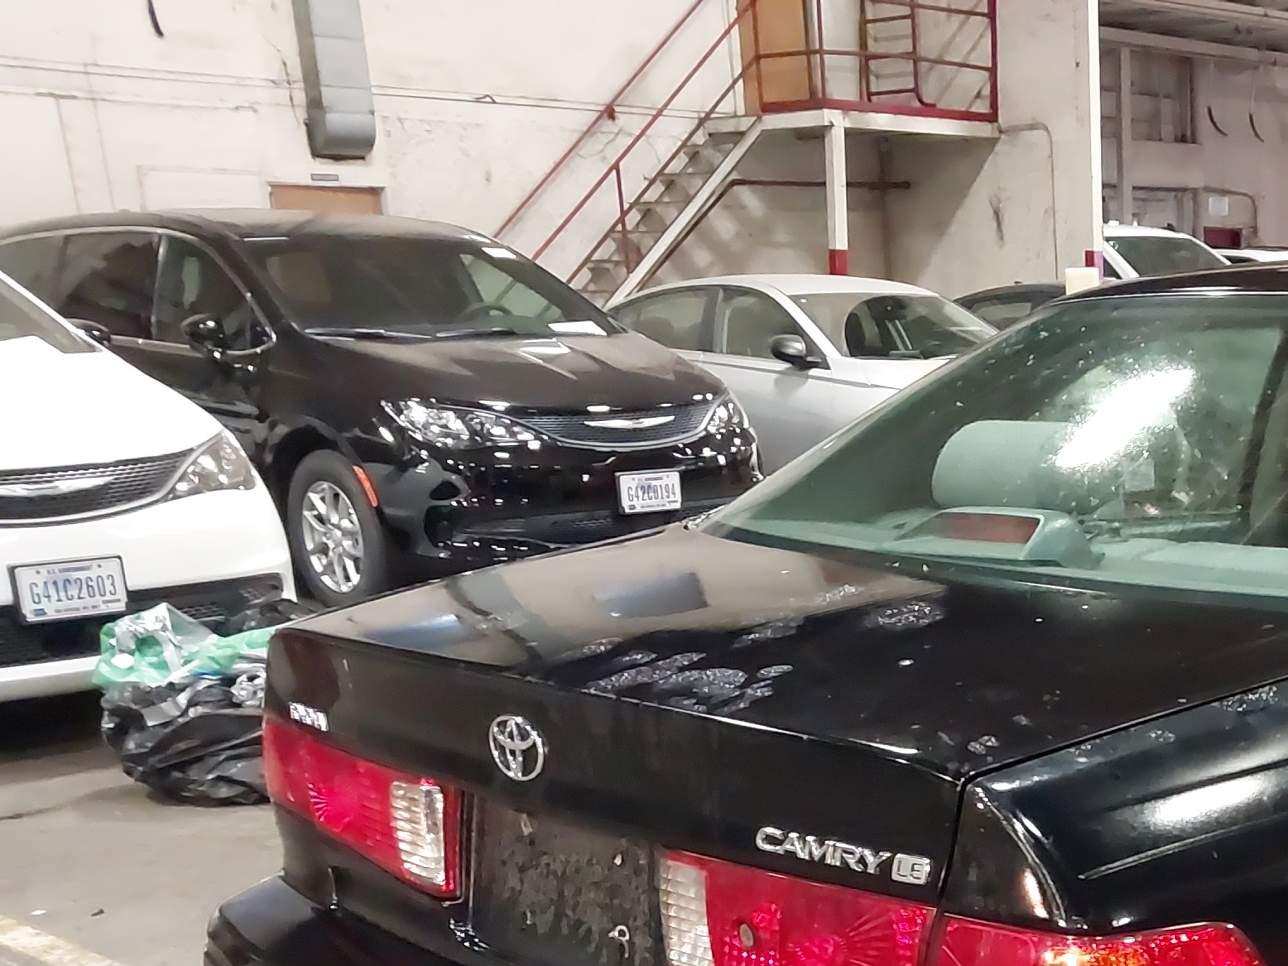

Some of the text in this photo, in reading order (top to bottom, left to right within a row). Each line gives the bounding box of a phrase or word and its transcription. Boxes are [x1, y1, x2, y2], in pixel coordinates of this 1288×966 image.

[29, 574, 117, 605] G41C2603
[755, 826, 928, 883] CAMRY LE
